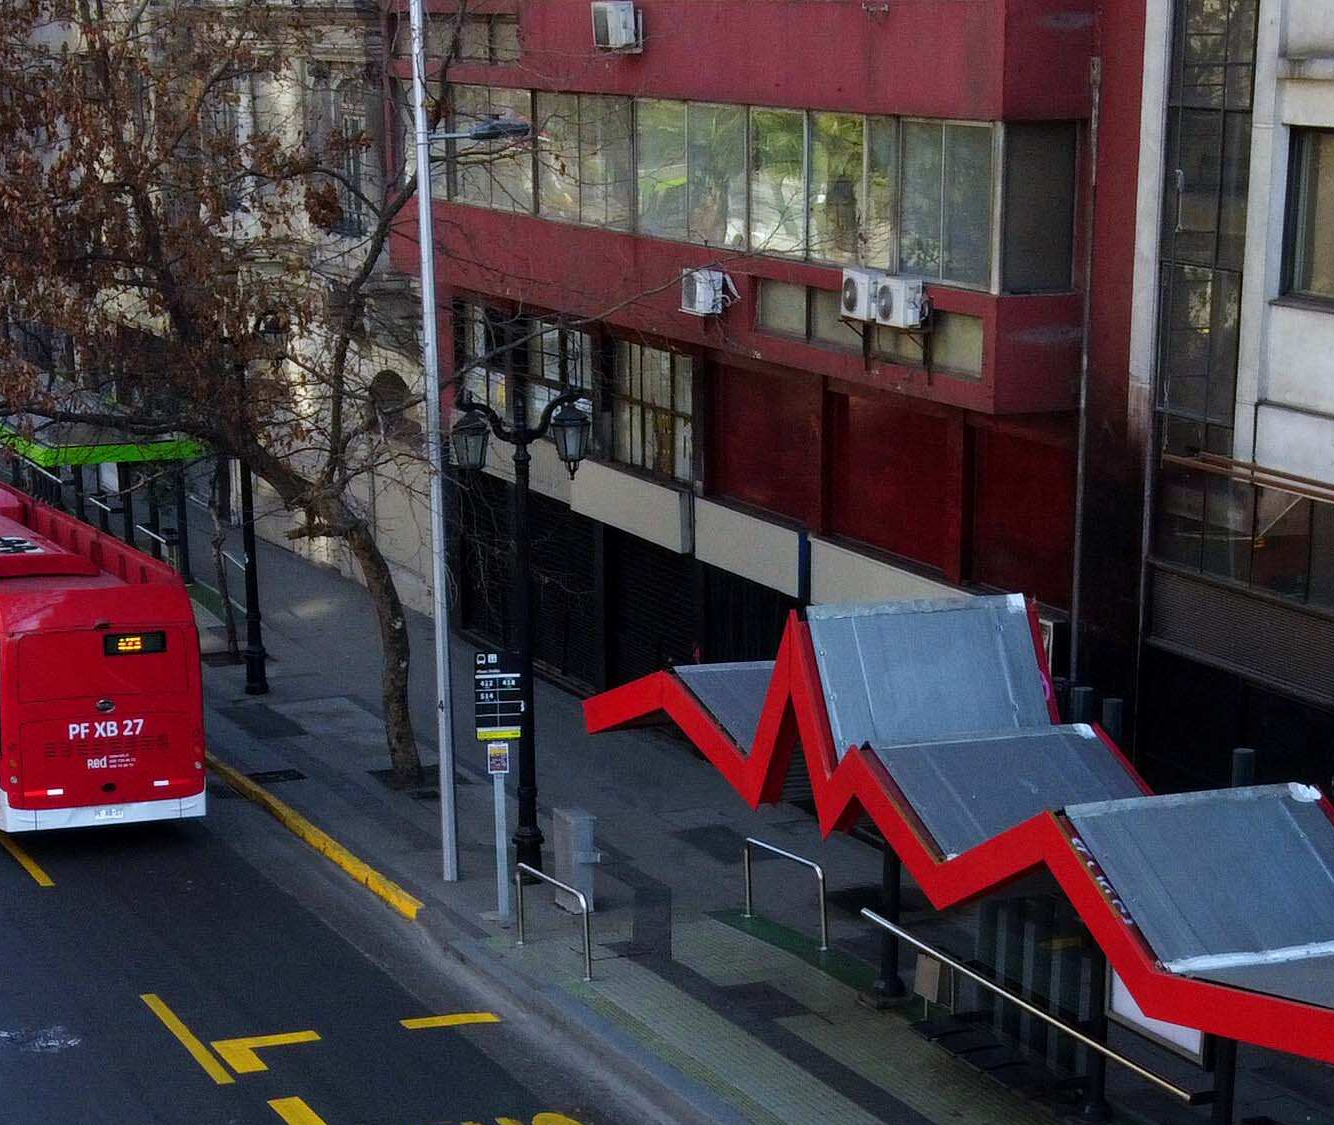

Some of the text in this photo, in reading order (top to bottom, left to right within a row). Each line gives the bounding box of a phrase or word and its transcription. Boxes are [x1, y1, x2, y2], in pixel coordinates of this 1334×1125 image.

[68, 718, 144, 740] PF XB 27
